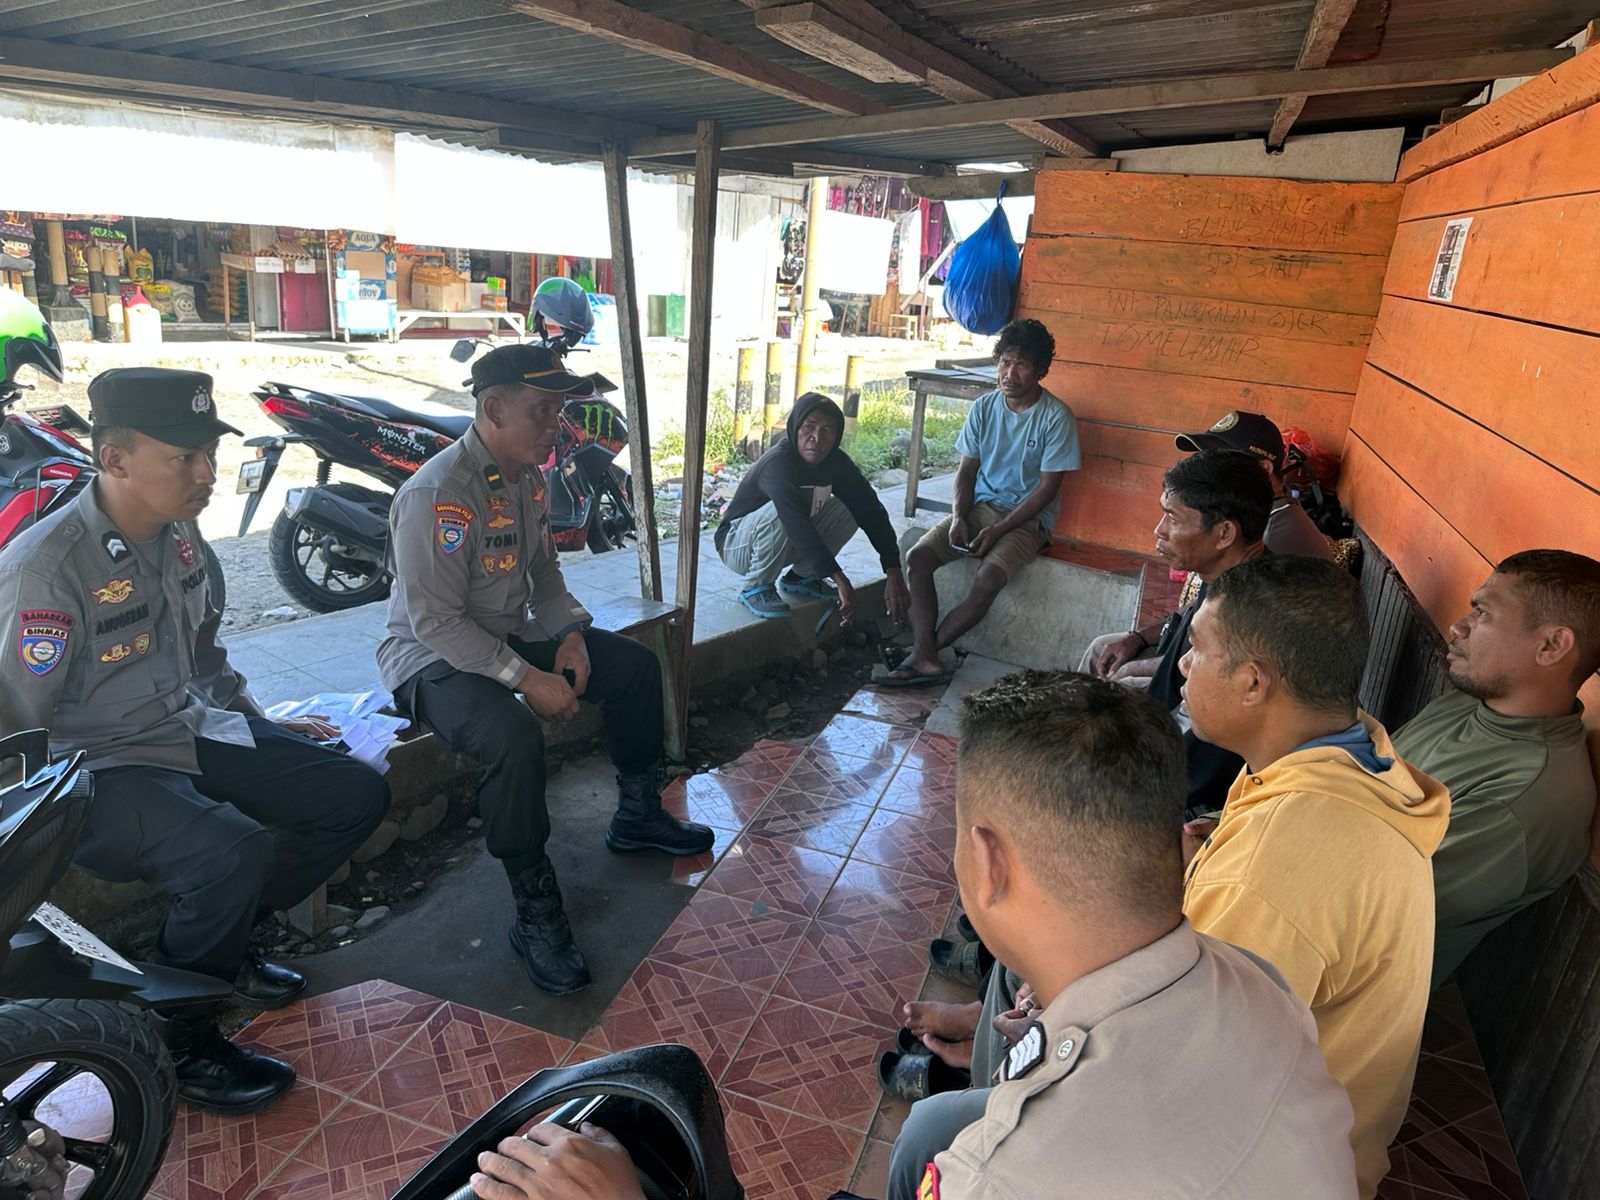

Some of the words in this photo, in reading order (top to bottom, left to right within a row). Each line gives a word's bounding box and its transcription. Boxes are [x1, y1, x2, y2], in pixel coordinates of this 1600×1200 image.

[355, 232, 376, 244] AQUA
[1154, 295, 1256, 324] PANGKALAN
[1267, 308, 1329, 336] OJEK
[377, 425, 426, 455] MONSTER
[49, 469, 73, 477] HONDA
[484, 532, 517, 548] TOMI
[96, 603, 149, 636] ANUGERAH
[26, 628, 66, 638] BINMAS
